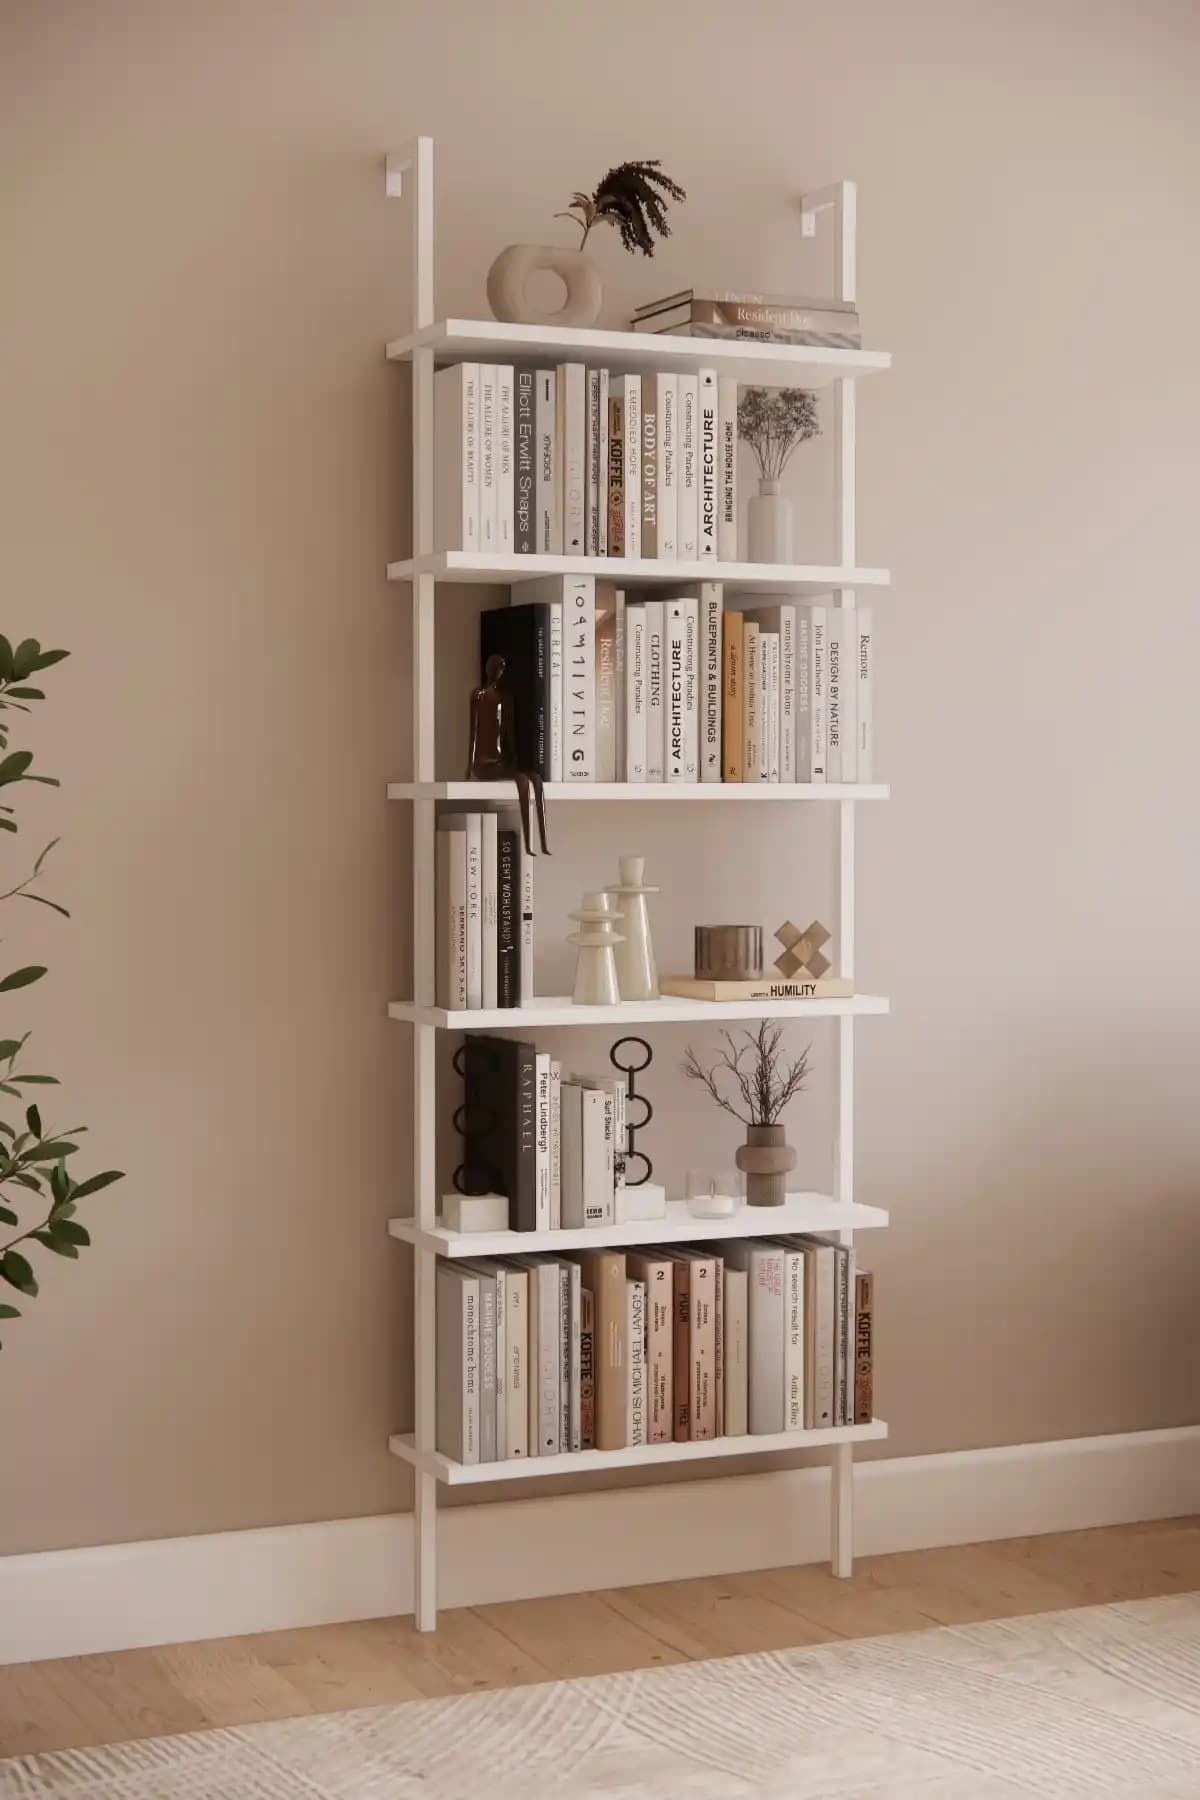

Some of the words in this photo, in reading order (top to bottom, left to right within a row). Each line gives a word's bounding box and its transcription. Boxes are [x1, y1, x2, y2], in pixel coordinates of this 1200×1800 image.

[484, 384, 492, 402] THE
[501, 385, 509, 402] THE
[519, 373, 532, 417] Elliott
[484, 404, 492, 437] ALLURE
[501, 405, 509, 438] ALLURE
[664, 391, 673, 447] Constructing
[684, 392, 694, 449] Constructing
[725, 422, 733, 442] HOME
[467, 436, 474, 448] OF
[484, 439, 492, 452] OF
[501, 440, 509, 451] OF
[519, 424, 532, 471] Erwitt
[644, 413, 655, 460] BODY
[484, 453, 492, 488] WOMEN
[501, 455, 509, 474] MEN
[611, 438, 622, 487] KOFFIE
[685, 451, 694, 488] Paradies
[703, 409, 714, 537] ARCHITECTURE
[725, 444, 733, 468] HOUSE
[644, 464, 655, 487] OF
[725, 470, 733, 485] THE
[517, 476, 532, 532] Snaps
[644, 490, 655, 526] ART
[725, 487, 733, 522] BRINGING
[633, 624, 643, 677] Constructing
[685, 616, 695, 672] Constructing
[708, 602, 717, 671] BLUEPRINTS
[784, 620, 794, 685] monochrome
[814, 625, 824, 646] John
[650, 635, 660, 707] CLOTHING
[815, 648, 823, 696] Lanchester
[830, 642, 839, 683] DESIGN
[860, 634, 870, 679] Remote
[686, 674, 695, 711] Paradies
[708, 673, 717, 681] &
[830, 686, 839, 700] BY
[672, 640, 681, 759] ARCHITECTURE
[707, 685, 717, 743] BUILDINGS
[784, 689, 794, 716] home
[830, 703, 839, 747] NATURE
[502, 841, 511, 852] SO
[502, 857, 511, 880] GEHT
[771, 984, 816, 996] HUMILITY
[540, 1073, 548, 1099] Peter
[522, 1064, 532, 1153] RAPHAEL
[604, 1100, 612, 1115] Surf
[538, 1102, 548, 1153] Lindbergh
[656, 1271, 664, 1281] 2
[700, 1268, 706, 1278] 2
[791, 1258, 799, 1271] No
[791, 1274, 799, 1304] search
[467, 1296, 476, 1362] monochrome
[632, 1294, 642, 1334] JANG?
[791, 1306, 799, 1331] result
[791, 1333, 799, 1345] for
[857, 1312, 871, 1358] KOFFIE
[580, 1332, 592, 1380] KOFFIE
[467, 1366, 476, 1394] home
[632, 1397, 642, 1409] IS
[632, 1412, 642, 1446] WHO
